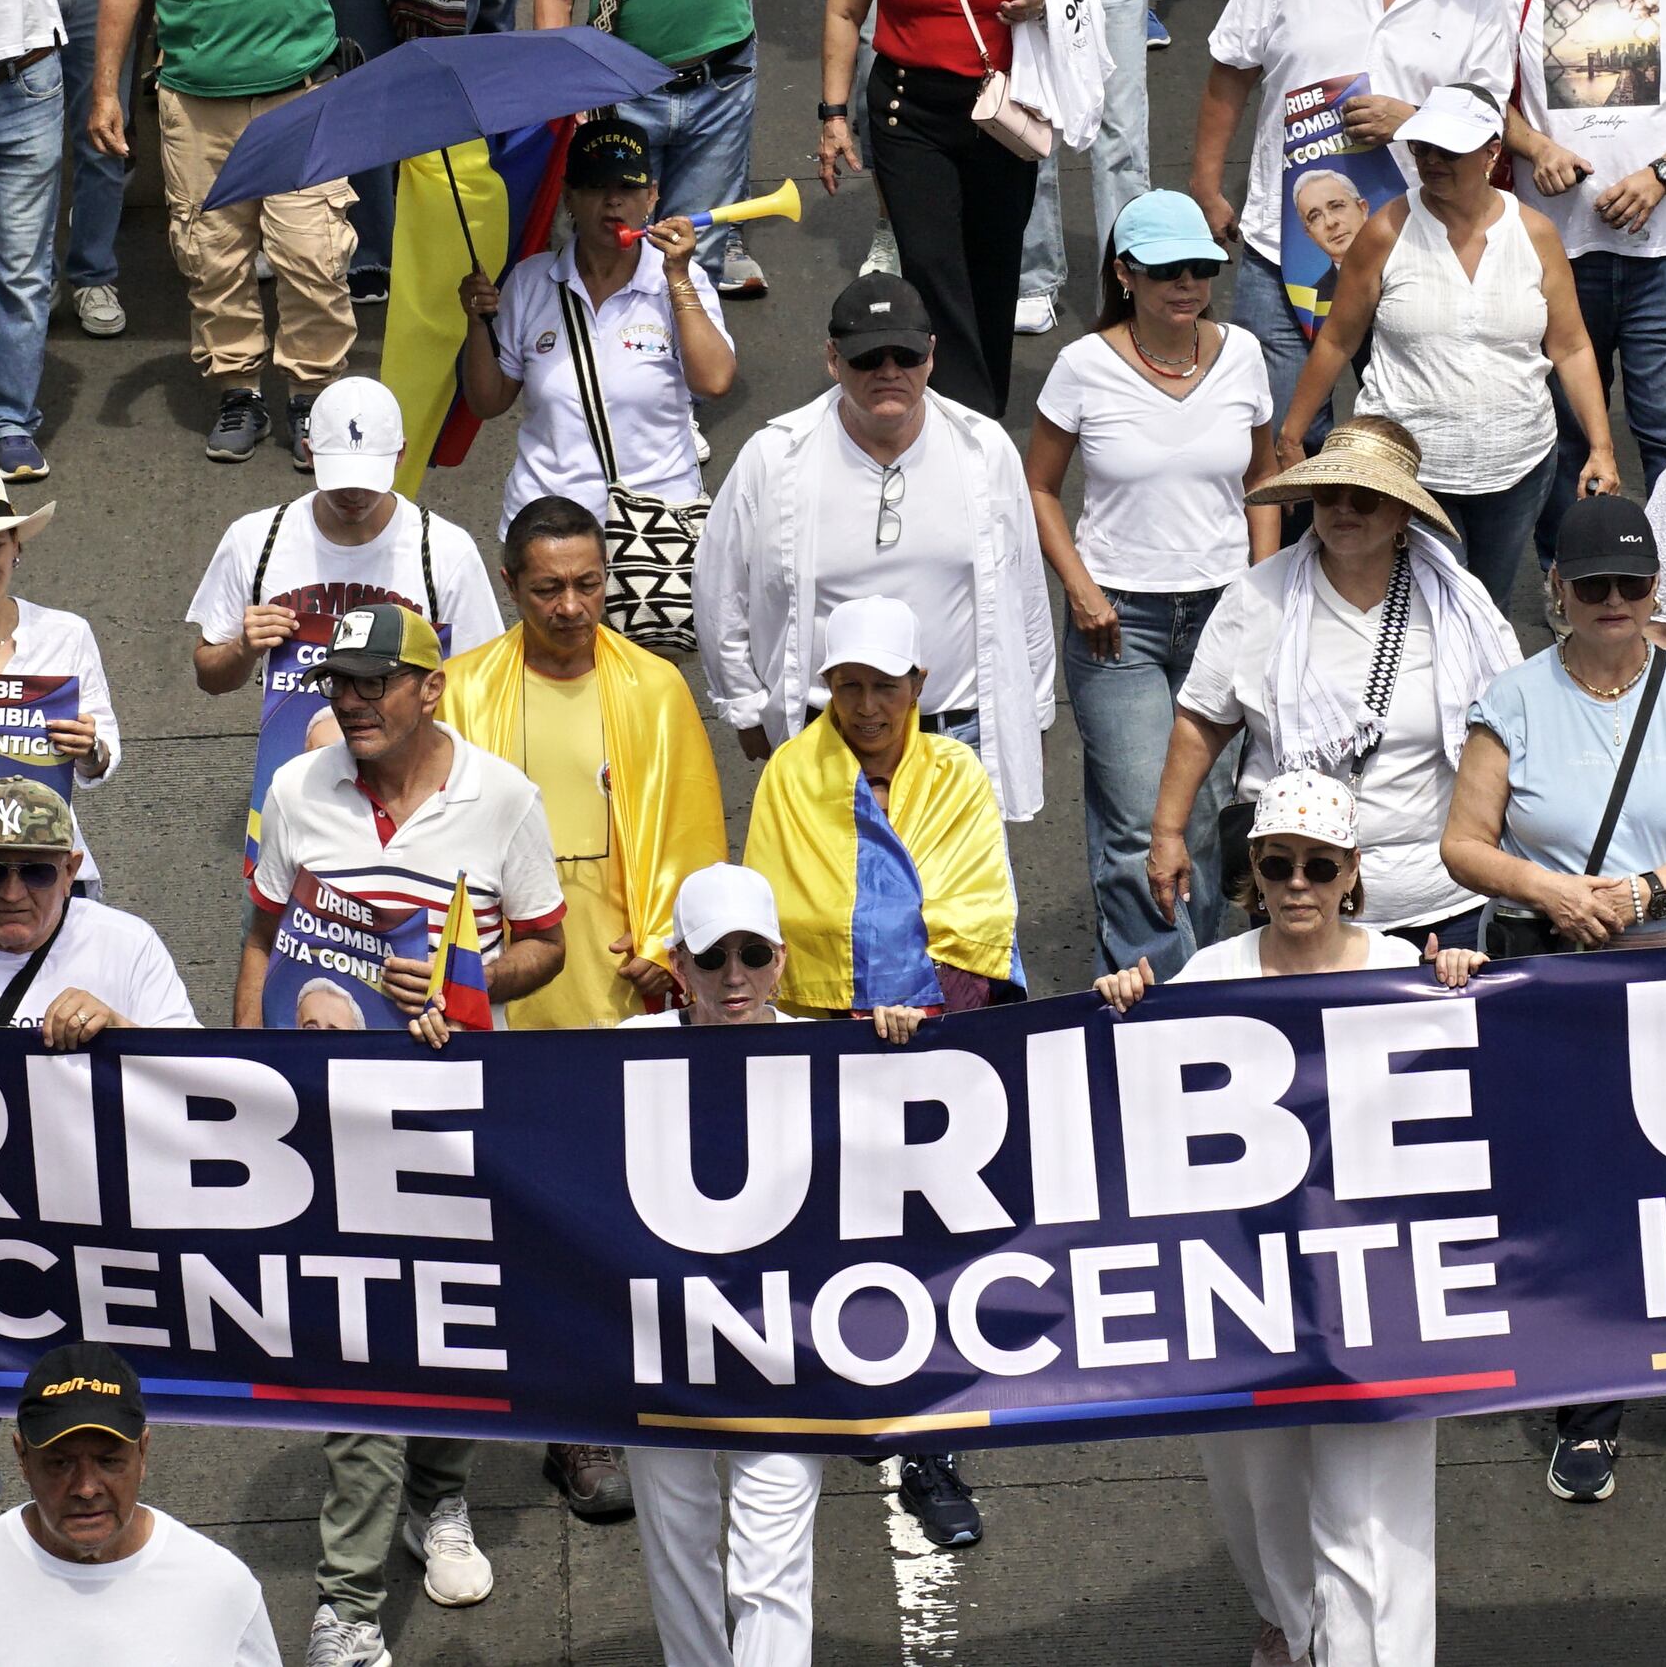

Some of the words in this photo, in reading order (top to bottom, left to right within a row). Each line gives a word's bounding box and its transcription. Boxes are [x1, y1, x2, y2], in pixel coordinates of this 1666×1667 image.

[1285, 87, 1326, 116] RIBE
[1285, 107, 1342, 143] LOMBI
[583, 134, 643, 155] VETERANO
[619, 324, 672, 342] VETERAN
[315, 887, 375, 928] URIBE
[292, 907, 396, 961] COLOMBIA
[275, 929, 315, 967] ESTA
[318, 944, 385, 985] CONT
[624, 997, 1491, 1255] URIBE
[629, 1215, 1510, 1387] INOCENTE
[41, 1377, 122, 1396] can-am
